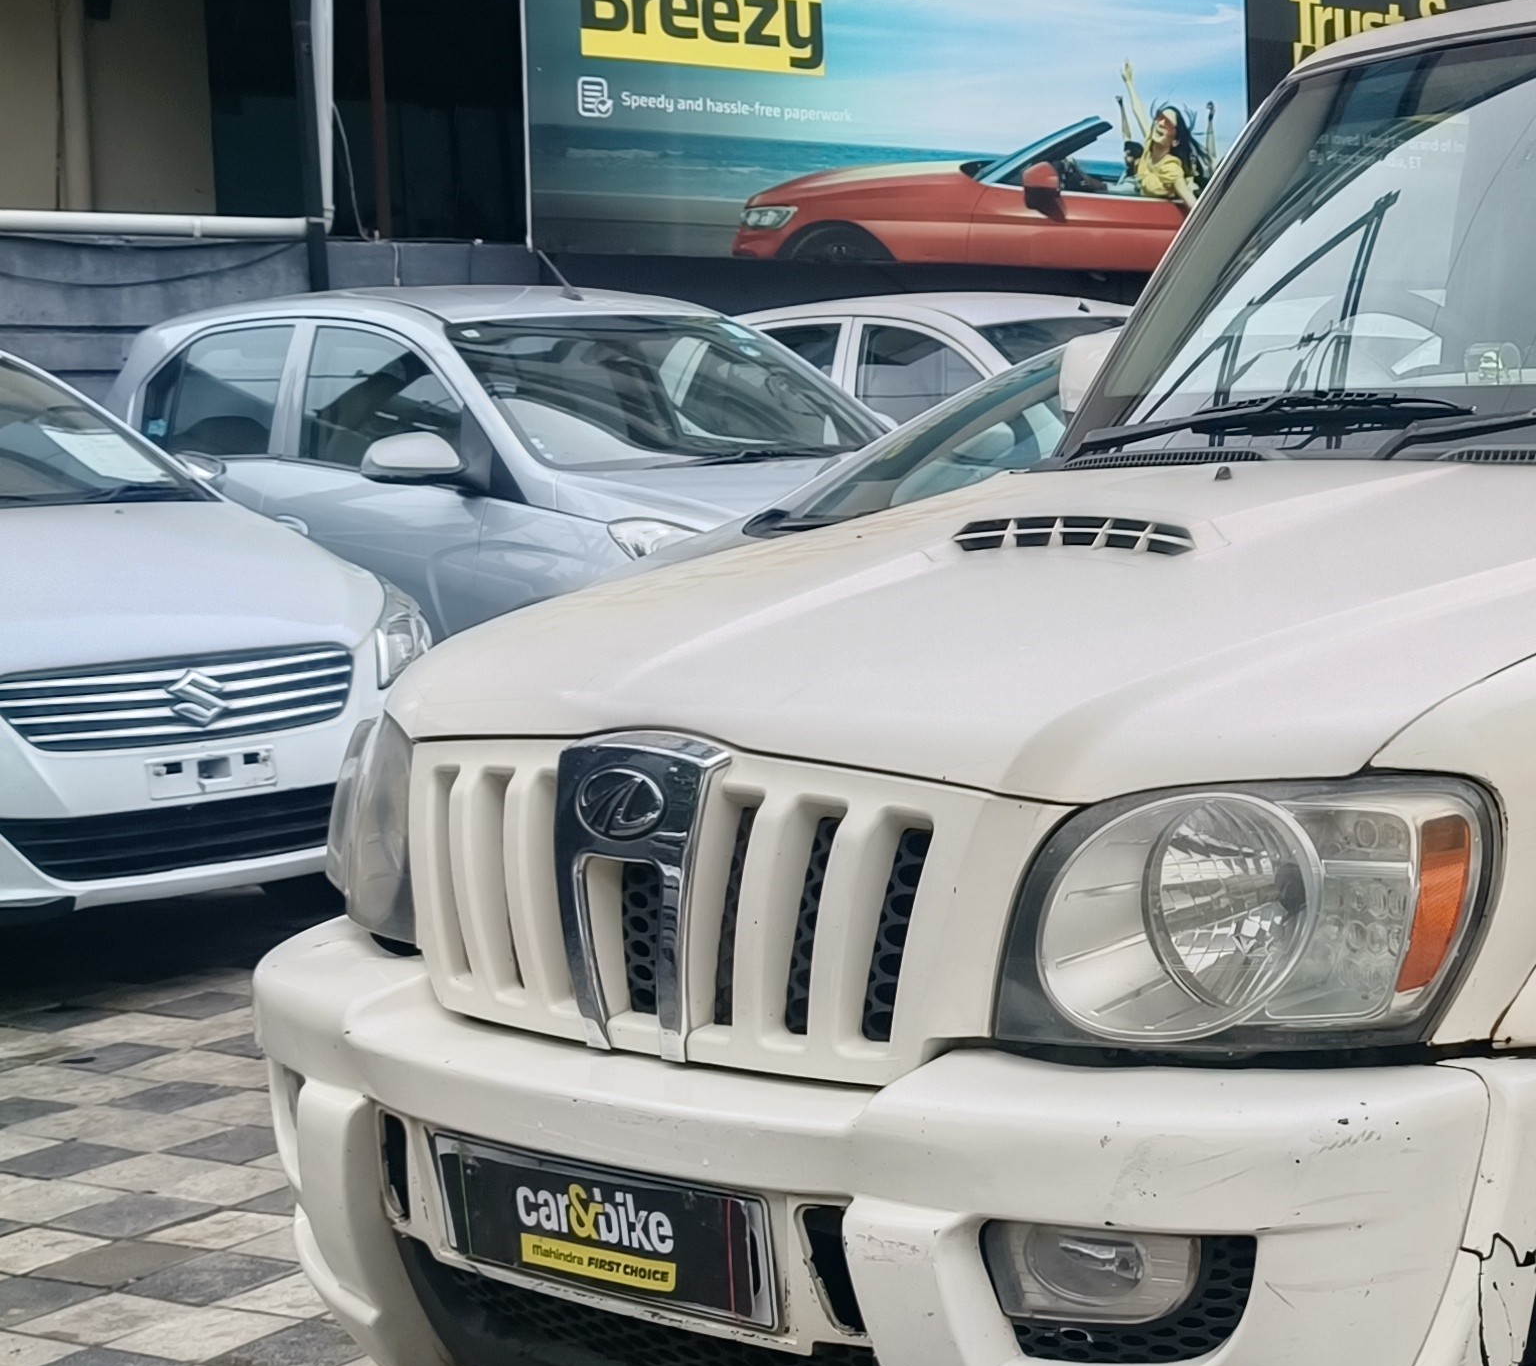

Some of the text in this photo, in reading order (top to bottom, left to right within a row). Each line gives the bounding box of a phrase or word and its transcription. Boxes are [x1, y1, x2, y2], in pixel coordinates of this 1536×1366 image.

[621, 91, 852, 122] Speedy and hassle-free paperwork
[516, 1183, 674, 1254] car&bike
[532, 1244, 669, 1283] Mahindra FIRST CHOICE
